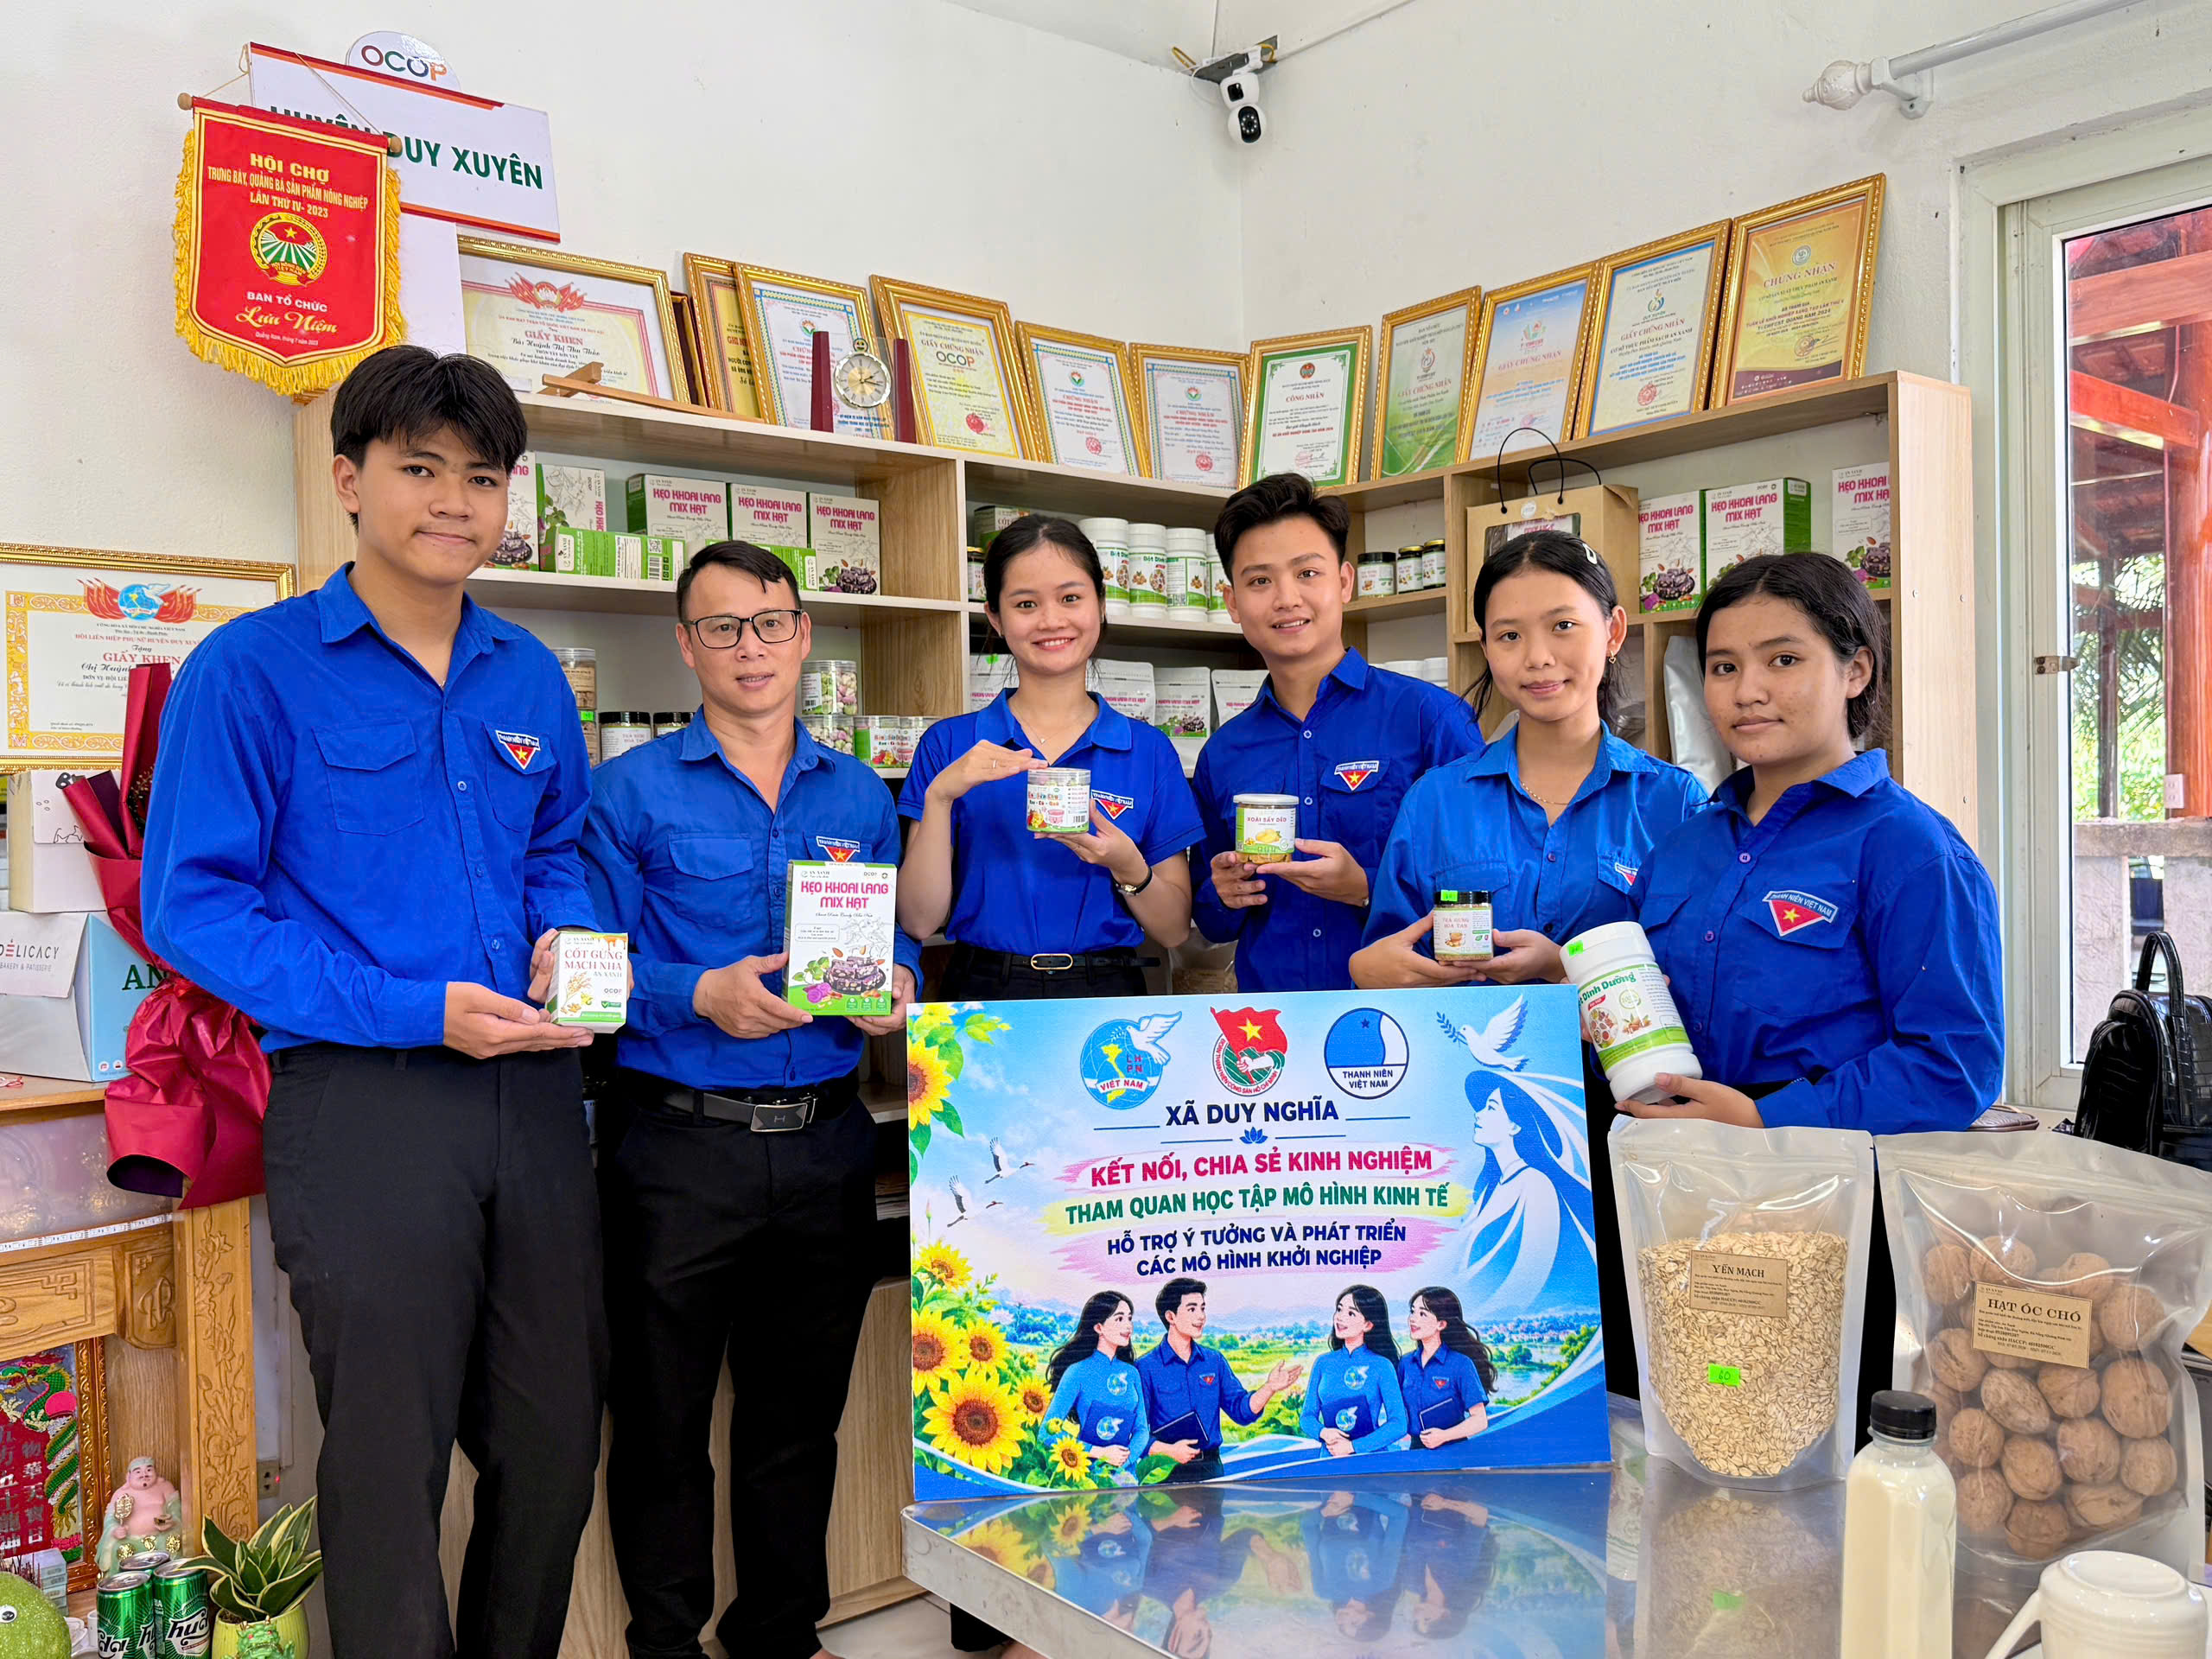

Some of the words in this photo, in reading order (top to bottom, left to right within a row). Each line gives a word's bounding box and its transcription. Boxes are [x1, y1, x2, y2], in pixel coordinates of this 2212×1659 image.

[361, 45, 447, 81] OCOP
[250, 153, 283, 174] HỘI
[289, 162, 330, 185] CHỢ
[454, 145, 543, 189] XUYÊN
[250, 172, 274, 190] QUẢNG
[275, 178, 285, 193] BÁ
[286, 177, 301, 196] SẢN
[323, 188, 342, 207] NÔNG
[344, 194, 368, 212] NGHIỆP
[307, 204, 328, 219] 2023
[247, 291, 273, 303] BAN
[276, 293, 292, 307] TỔ
[295, 299, 327, 313] CHỨC
[236, 306, 281, 328] Lưu
[284, 311, 338, 334] Niệm
[524, 329, 552, 341] GIẤY
[554, 334, 583, 346] KHEN
[936, 351, 975, 366] OCOP
[1838, 480, 1856, 493] KẸO
[1859, 476, 1886, 489] KHOAI
[653, 488, 671, 501] KẸO
[672, 490, 698, 502] KHOAI
[699, 493, 721, 504] LANG
[1711, 499, 1727, 512] KẸO
[1728, 495, 1753, 510] KHOAI
[1755, 493, 1777, 506] LANG
[1854, 490, 1873, 504] MIX
[1877, 489, 1890, 501] HẠ
[670, 502, 688, 513] MIX
[690, 505, 708, 516] HẠT
[738, 497, 754, 510] KẸO
[756, 499, 781, 510] KHOAI
[782, 502, 803, 512] LANG
[753, 511, 770, 521] MIX
[772, 512, 789, 524] HẠT
[817, 505, 831, 518] KẸO
[832, 507, 855, 518] KHOAI
[856, 510, 875, 521] LANG
[1650, 508, 1673, 521] KHOAI
[1674, 505, 1694, 517] LANG
[1726, 510, 1743, 523] MIX
[1744, 507, 1763, 521] HẠT
[830, 519, 847, 530] MIX
[848, 521, 863, 532] HẠT
[1648, 522, 1663, 533] MIX
[1664, 518, 1680, 531] HẠT
[103, 650, 137, 663] GIẤY
[143, 655, 181, 664] KHEN
[81, 663, 97, 672] Chị
[801, 880, 822, 895] KẸO
[825, 881, 858, 893] KHOAI
[861, 882, 888, 894] LANG
[820, 896, 843, 908] MIX
[846, 897, 869, 911] HẠT
[1789, 893, 1803, 904] NIÊN
[1803, 899, 1818, 910] VIỆT
[1818, 904, 1833, 917] NAM
[564, 947, 588, 959] CỐT
[591, 949, 623, 960] GỪNG
[565, 961, 596, 971] MẠCH
[600, 962, 622, 970] NHA
[1582, 985, 1601, 1001] Dinh
[1601, 972, 1637, 991] Dưỡng
[1373, 1069, 1394, 1078] NIÊN
[1124, 1079, 1143, 1090] NAM
[1349, 1079, 1370, 1090] VIỆT
[1370, 1079, 1389, 1089] NAM
[1166, 1098, 1204, 1127] XÃ
[1207, 1103, 1260, 1125] DUY
[1263, 1096, 1339, 1122] NGHĨA
[1091, 1157, 1135, 1187] KẾT
[1141, 1152, 1187, 1181] NỐI,
[1193, 1154, 1248, 1177] CHIA
[1255, 1146, 1281, 1173] SẺ
[1288, 1151, 1340, 1172] KINH
[1348, 1146, 1432, 1175] NGHIỆM
[1065, 1199, 1123, 1224] THAM
[1129, 1193, 1185, 1219] QUAN
[1192, 1190, 1233, 1215] HỌC
[1238, 1183, 1276, 1212] TẬP
[1283, 1181, 1313, 1206] MÔ
[1319, 1181, 1366, 1205] HÌNH
[1373, 1185, 1419, 1206] KINH
[1426, 1182, 1450, 1207] TẾ
[1108, 1230, 1135, 1255] HỖ
[1140, 1230, 1178, 1253] TRỢ
[1183, 1227, 1196, 1247] Ý
[1201, 1224, 1265, 1245] TƯỞNG
[1271, 1222, 1296, 1243] VÀ
[1302, 1221, 1350, 1241] PHÁT
[1355, 1218, 1406, 1241] TRIỂN
[1137, 1255, 1176, 1275] CÁC
[1182, 1251, 1211, 1272] MÔ
[1217, 1249, 1261, 1269] HÌNH
[1268, 1245, 1310, 1267] KHỞI
[1316, 1246, 1382, 1269] NGHIỆP
[1713, 1263, 1734, 1275] YẾN
[1737, 1267, 1764, 1278] MẠCH
[1987, 1298, 2017, 1313] HẠT
[2021, 1303, 2043, 1316] ÓC
[2047, 1308, 2081, 1322] CHÓ
